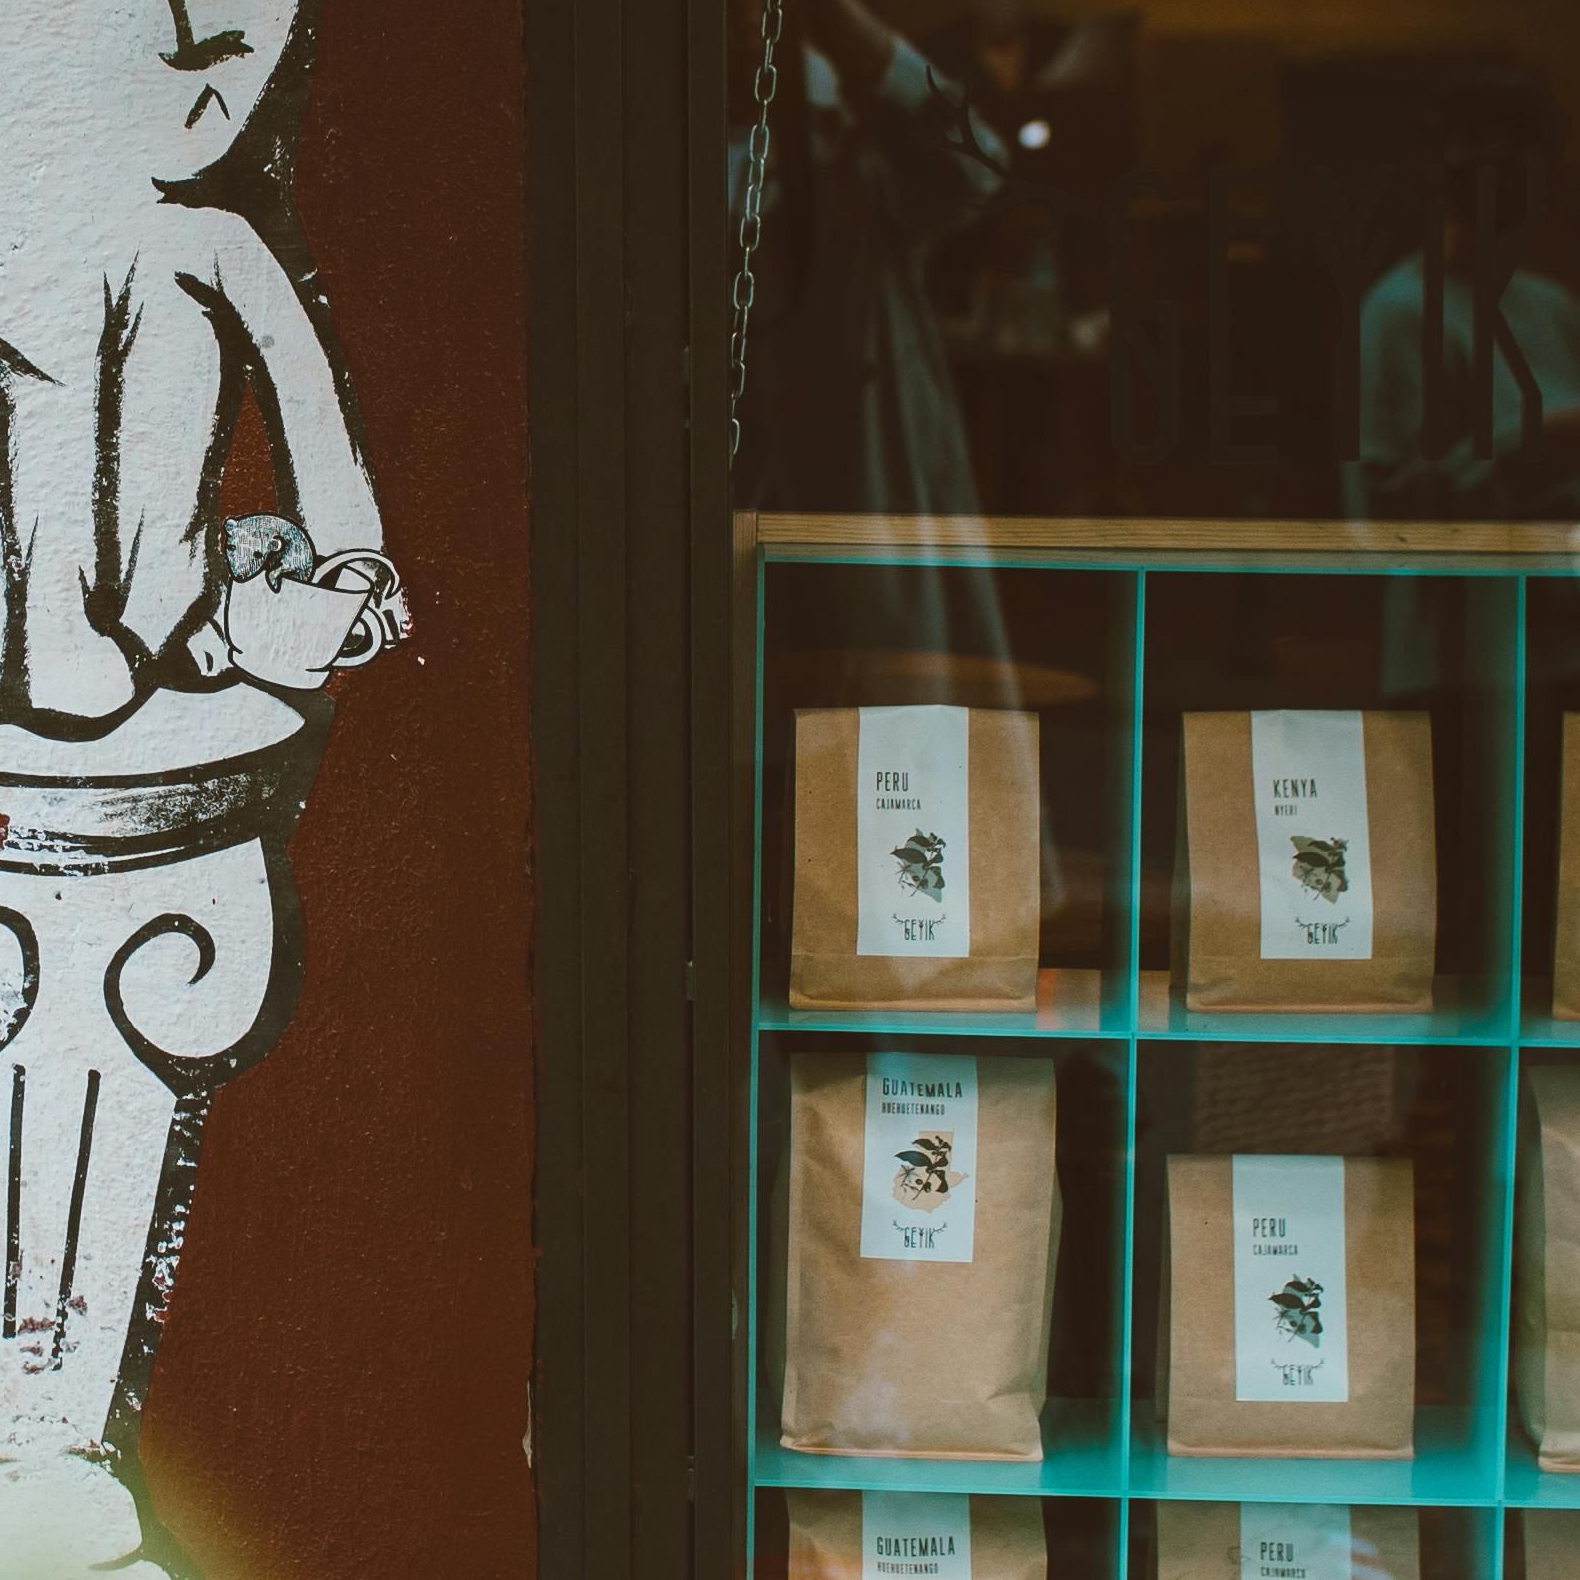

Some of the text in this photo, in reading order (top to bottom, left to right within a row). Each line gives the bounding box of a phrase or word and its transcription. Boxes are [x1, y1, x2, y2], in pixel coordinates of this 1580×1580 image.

[876, 772, 910, 792] PERU
[1273, 778, 1318, 799] KENYA
[876, 798, 922, 811] CAJAMARCA
[882, 1077, 963, 1099] GUATEMALA
[1252, 1218, 1287, 1238] PERU
[876, 1536, 956, 1557] GUATEMALA
[1260, 1542, 1294, 1562] PERU
